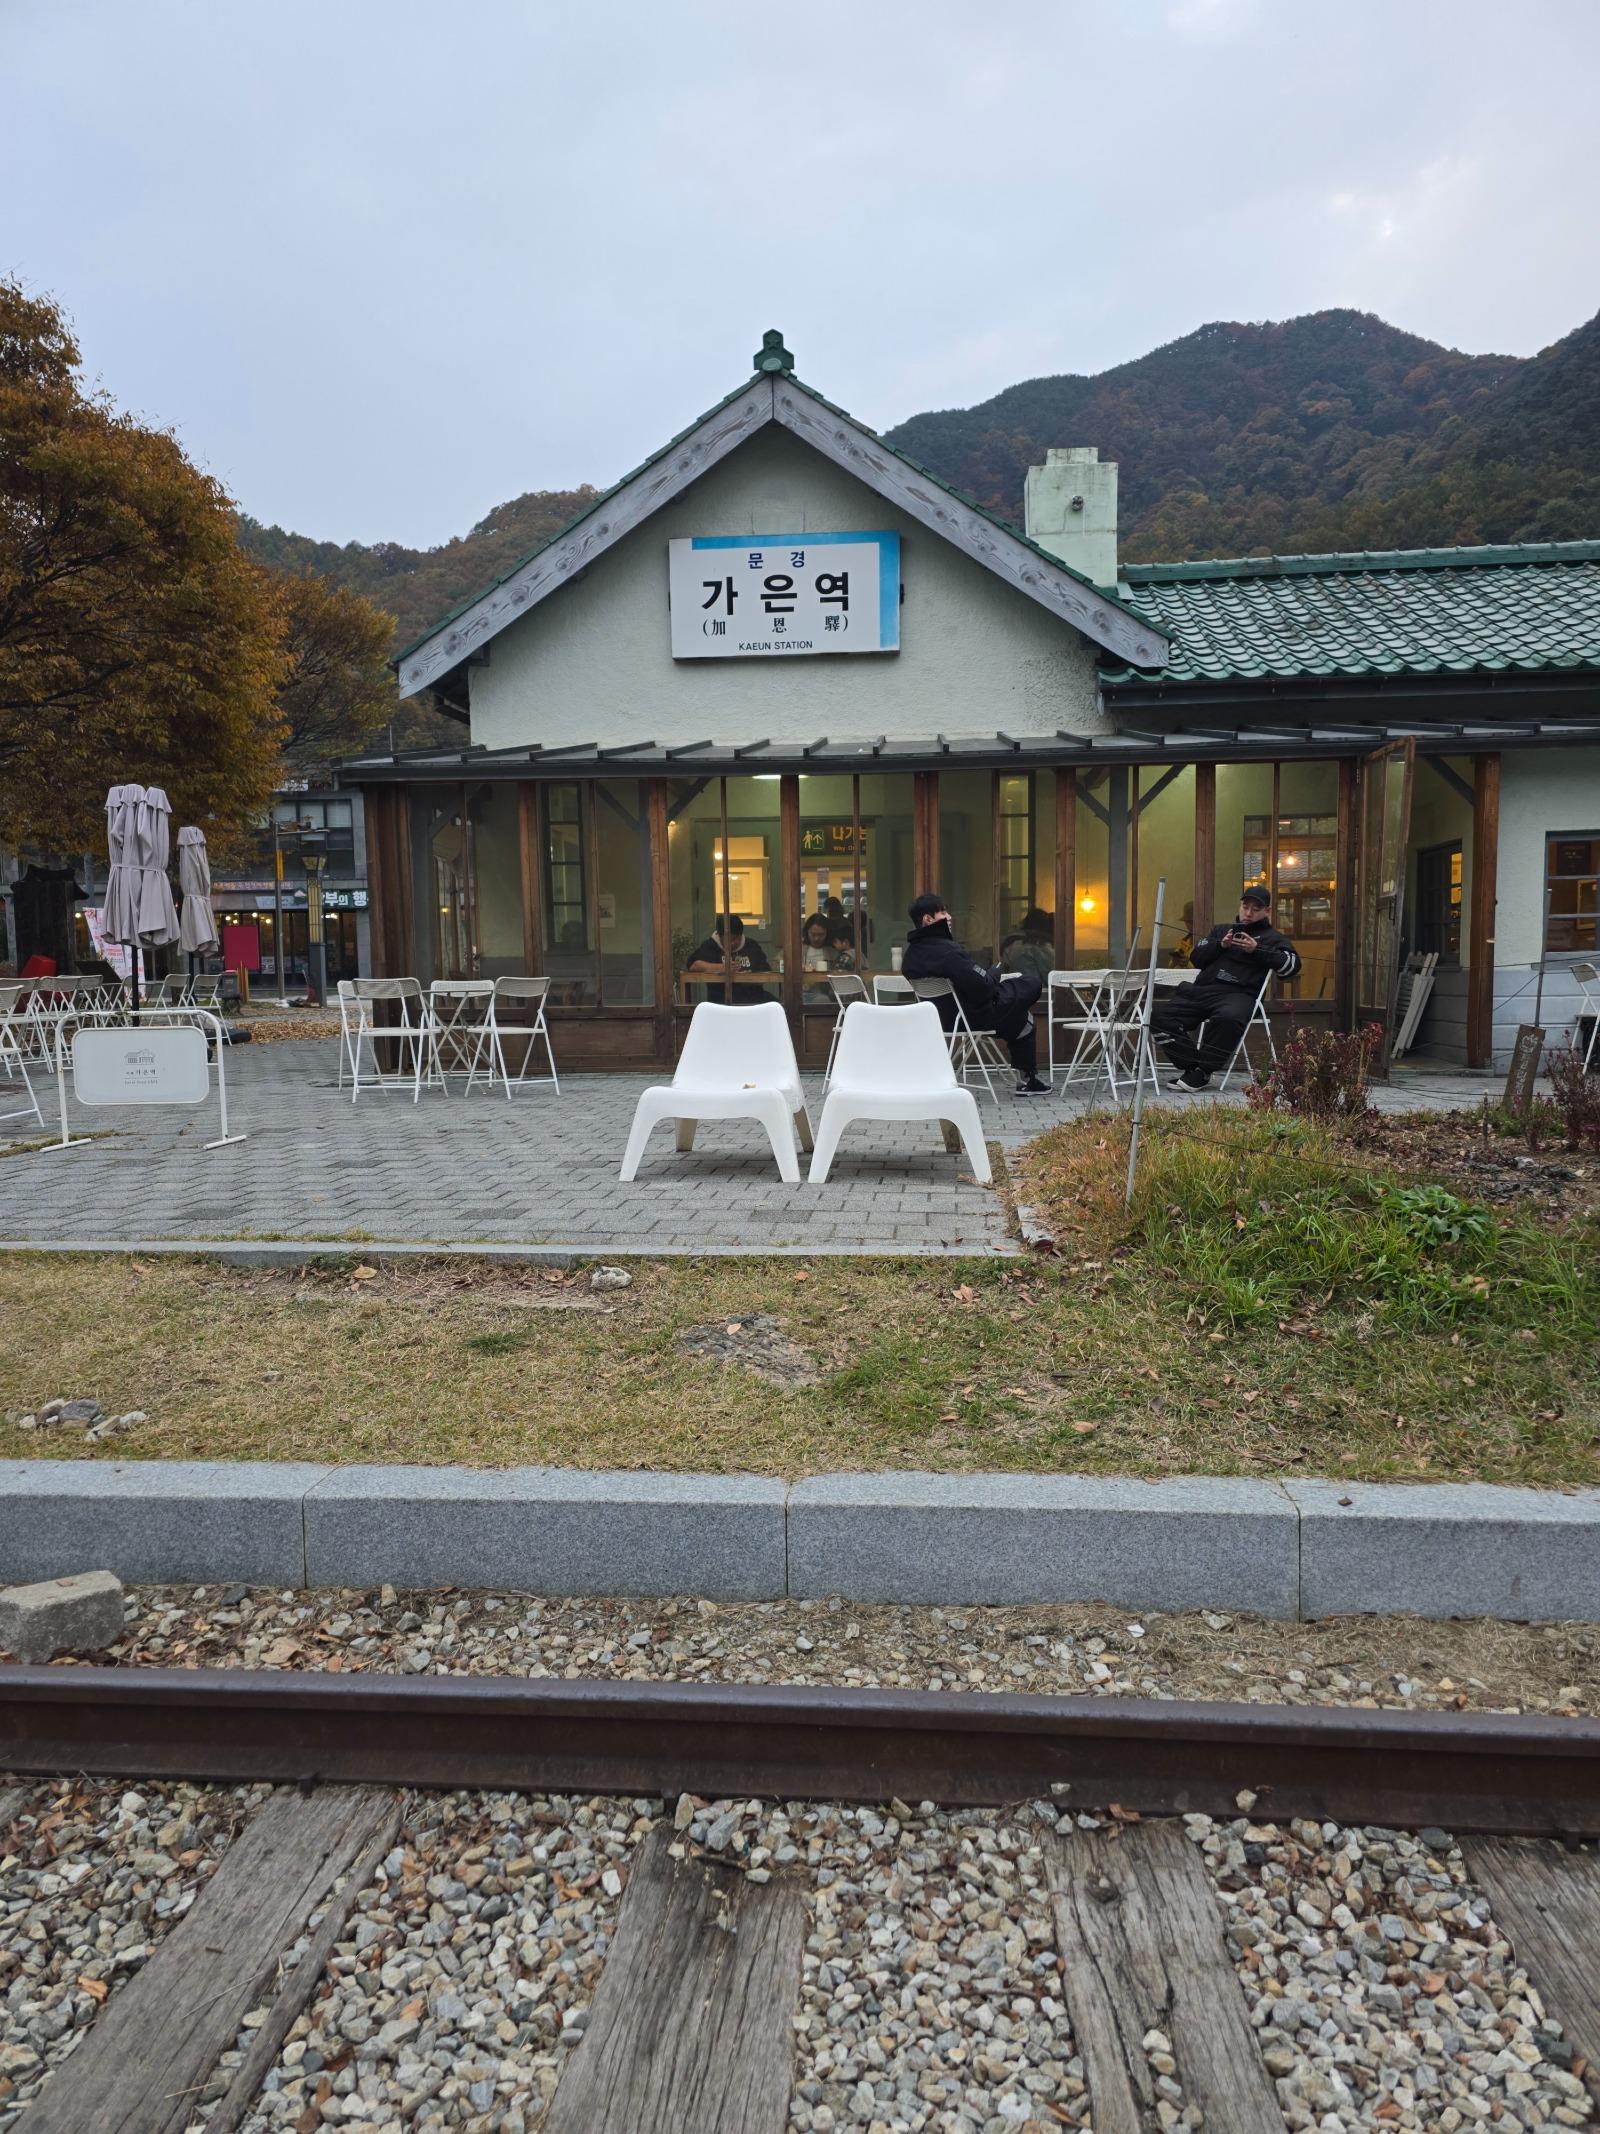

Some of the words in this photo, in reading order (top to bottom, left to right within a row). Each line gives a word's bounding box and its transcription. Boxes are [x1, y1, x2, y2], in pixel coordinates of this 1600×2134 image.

[748, 550, 806, 569] 문경
[701, 571, 849, 615] 가은역
[738, 642, 771, 651] KAEUN
[774, 641, 813, 650] STATION
[322, 891, 348, 906] 부의
[353, 890, 369, 907] 행
